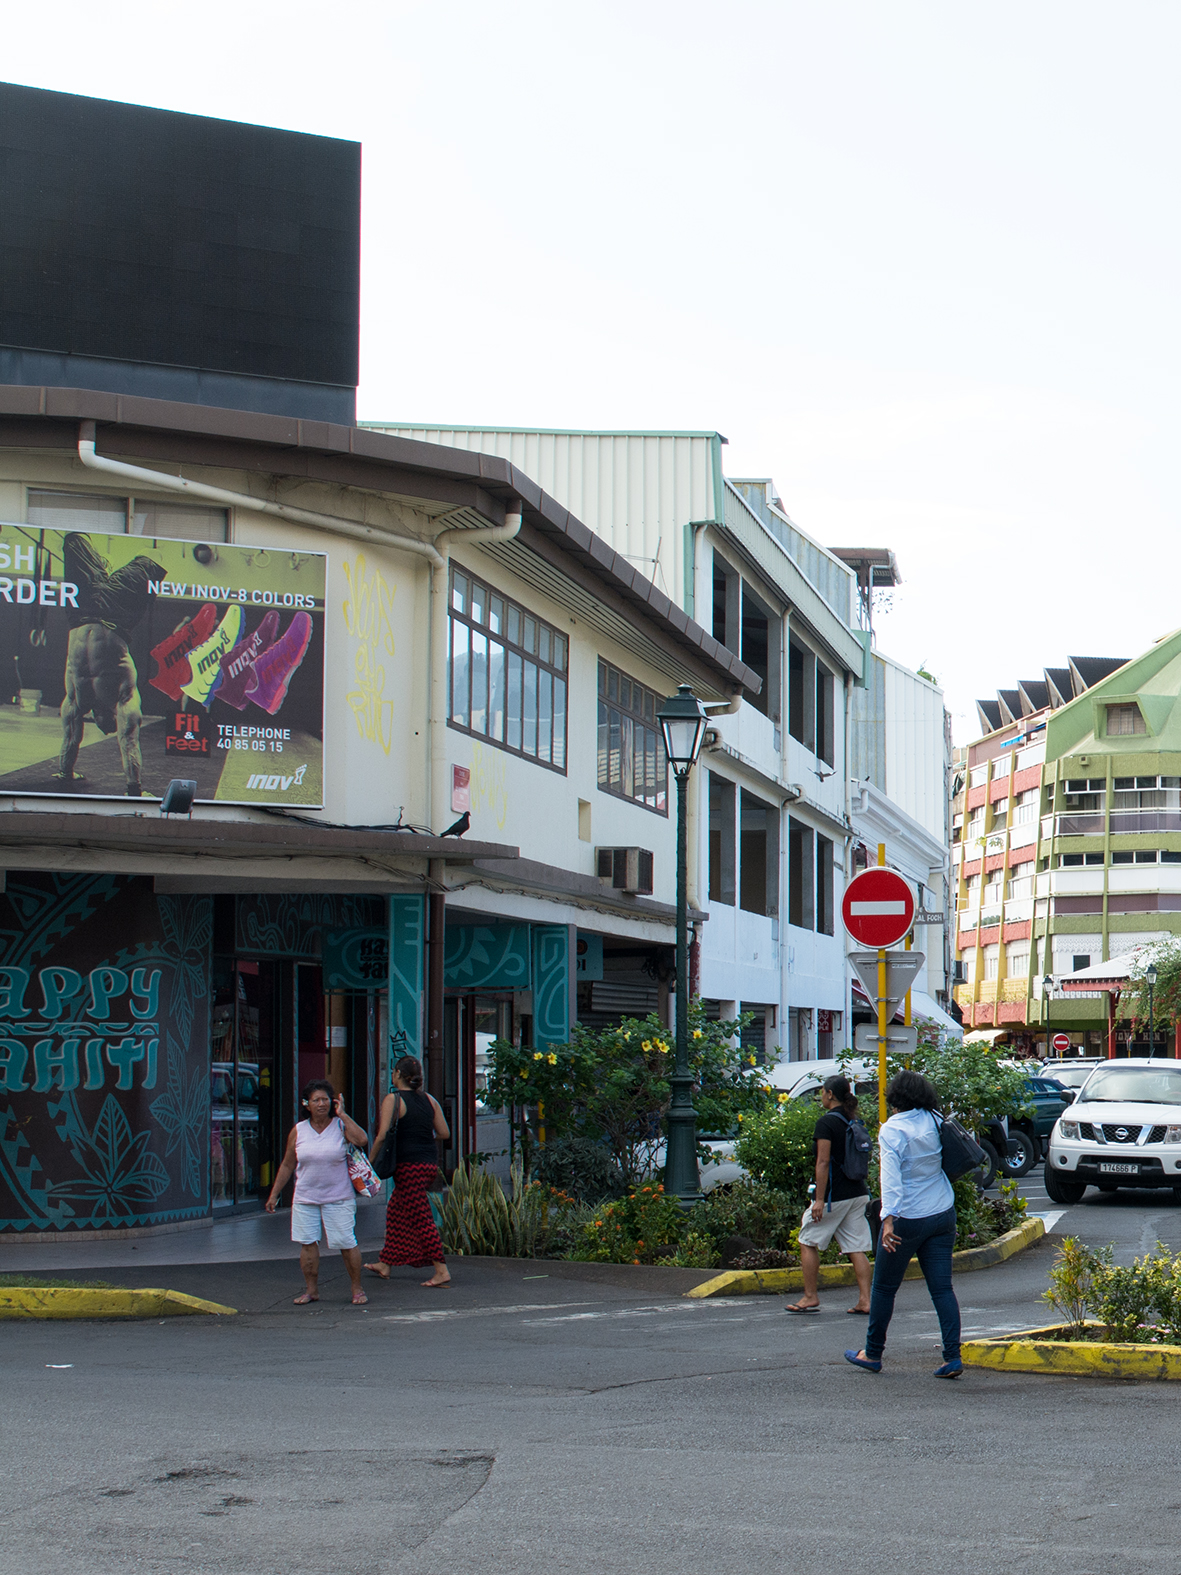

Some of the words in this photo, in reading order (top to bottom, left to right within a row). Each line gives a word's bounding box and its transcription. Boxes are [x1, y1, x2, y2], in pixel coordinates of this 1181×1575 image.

[147, 579, 188, 597] NEW
[191, 584, 248, 602] INOV-8
[251, 589, 316, 608] COLORS
[175, 713, 200, 732] Fit
[217, 724, 291, 740] TELEPHONE
[166, 736, 208, 752] Feet
[216, 738, 232, 749] 40
[234, 740, 249, 751] 85
[251, 740, 266, 752] 05
[270, 741, 283, 752] 15
[927, 914, 942, 922] FOCH
[1131, 1164, 1137, 1173] P
